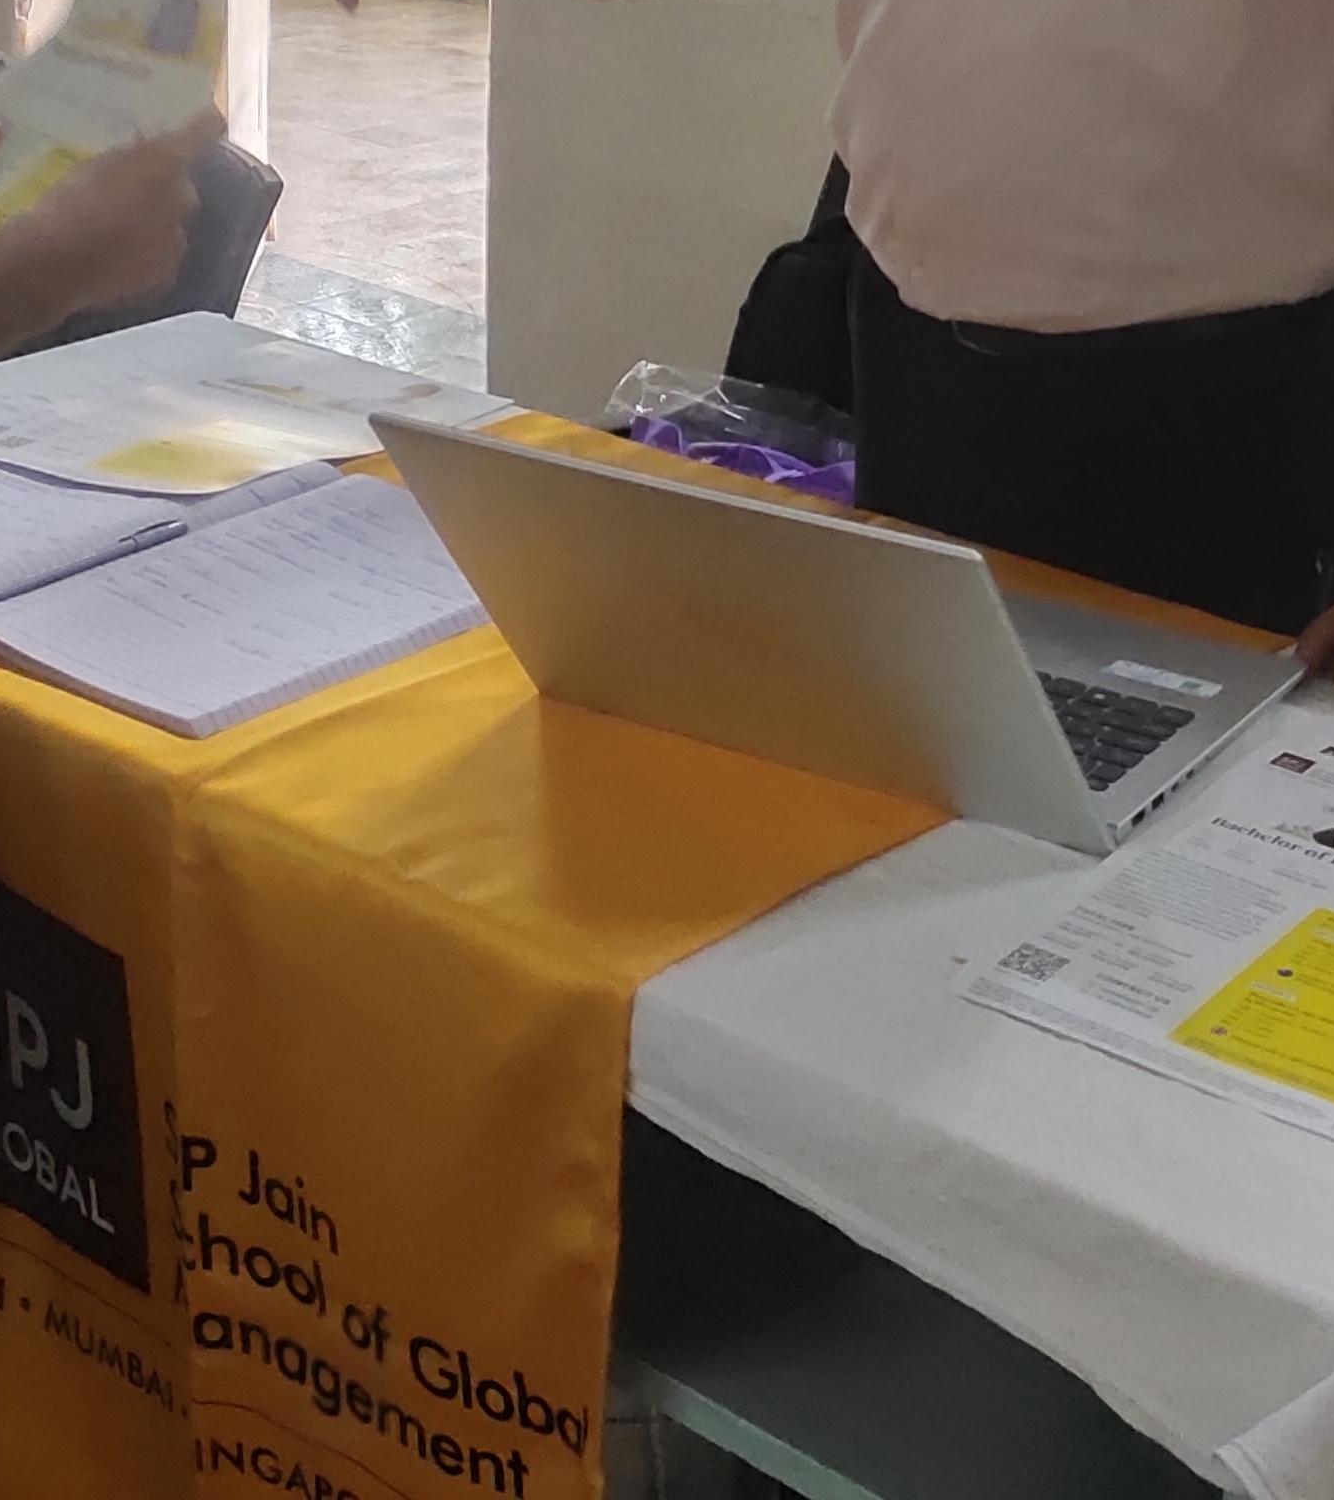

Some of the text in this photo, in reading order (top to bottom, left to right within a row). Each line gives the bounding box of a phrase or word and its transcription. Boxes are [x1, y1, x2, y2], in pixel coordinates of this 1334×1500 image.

[1211, 816, 1302, 854] Bachelor
[1304, 847, 1328, 864] of
[238, 1150, 339, 1256] Jain
[45, 1301, 174, 1413] MUMBAI
[342, 1304, 390, 1363] of
[409, 1335, 589, 1460] Global
[194, 1437, 359, 1500] INGAP
